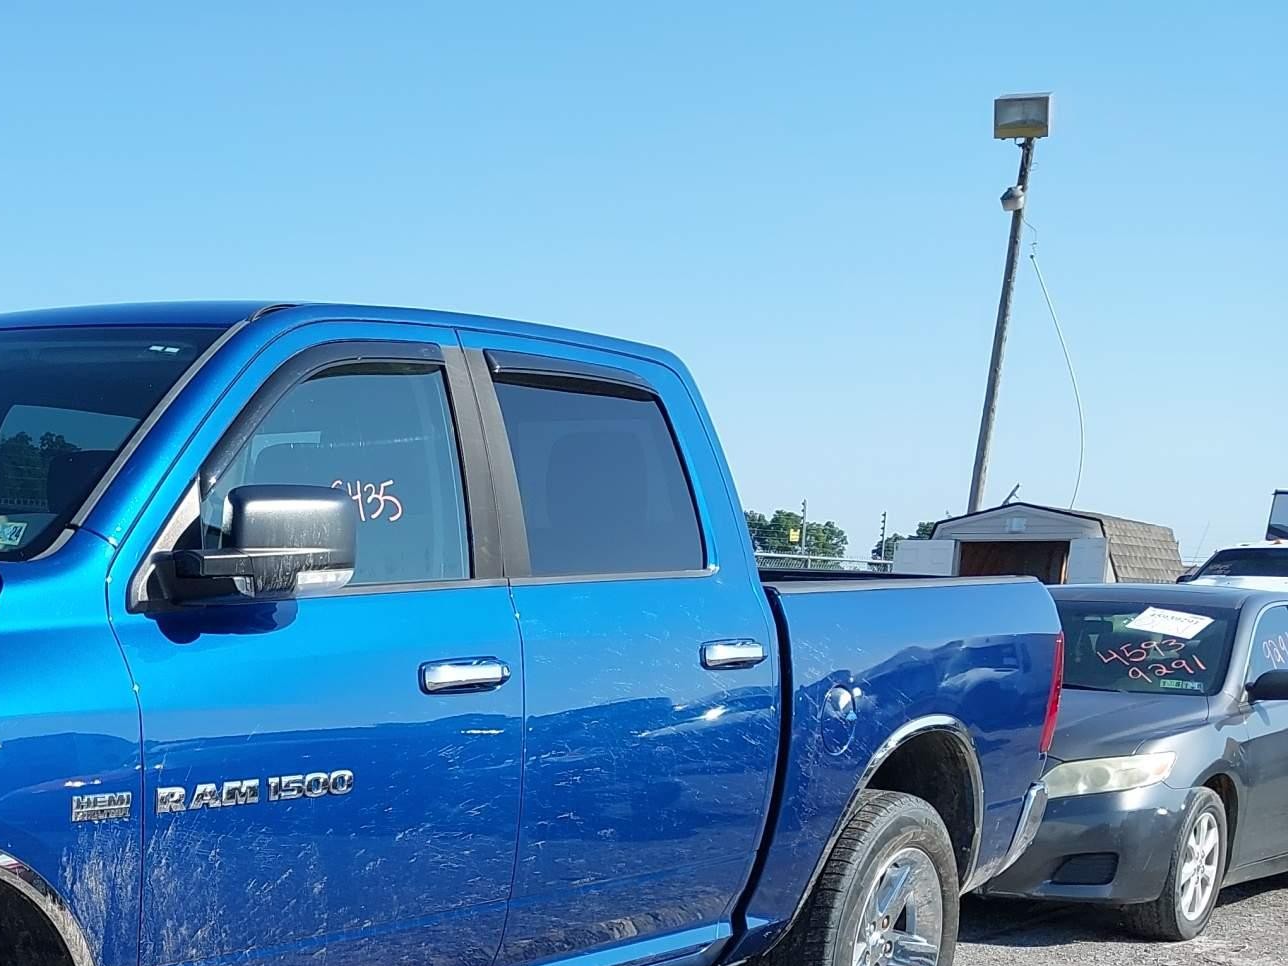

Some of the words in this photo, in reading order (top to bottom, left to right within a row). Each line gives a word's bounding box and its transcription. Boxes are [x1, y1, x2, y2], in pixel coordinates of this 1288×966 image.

[331, 479, 402, 521] 435
[1096, 638, 1185, 666] 4593
[1128, 654, 1207, 684] 9291
[72, 792, 132, 811] HEMI
[156, 778, 260, 814] RAM
[268, 769, 354, 801] 1500
